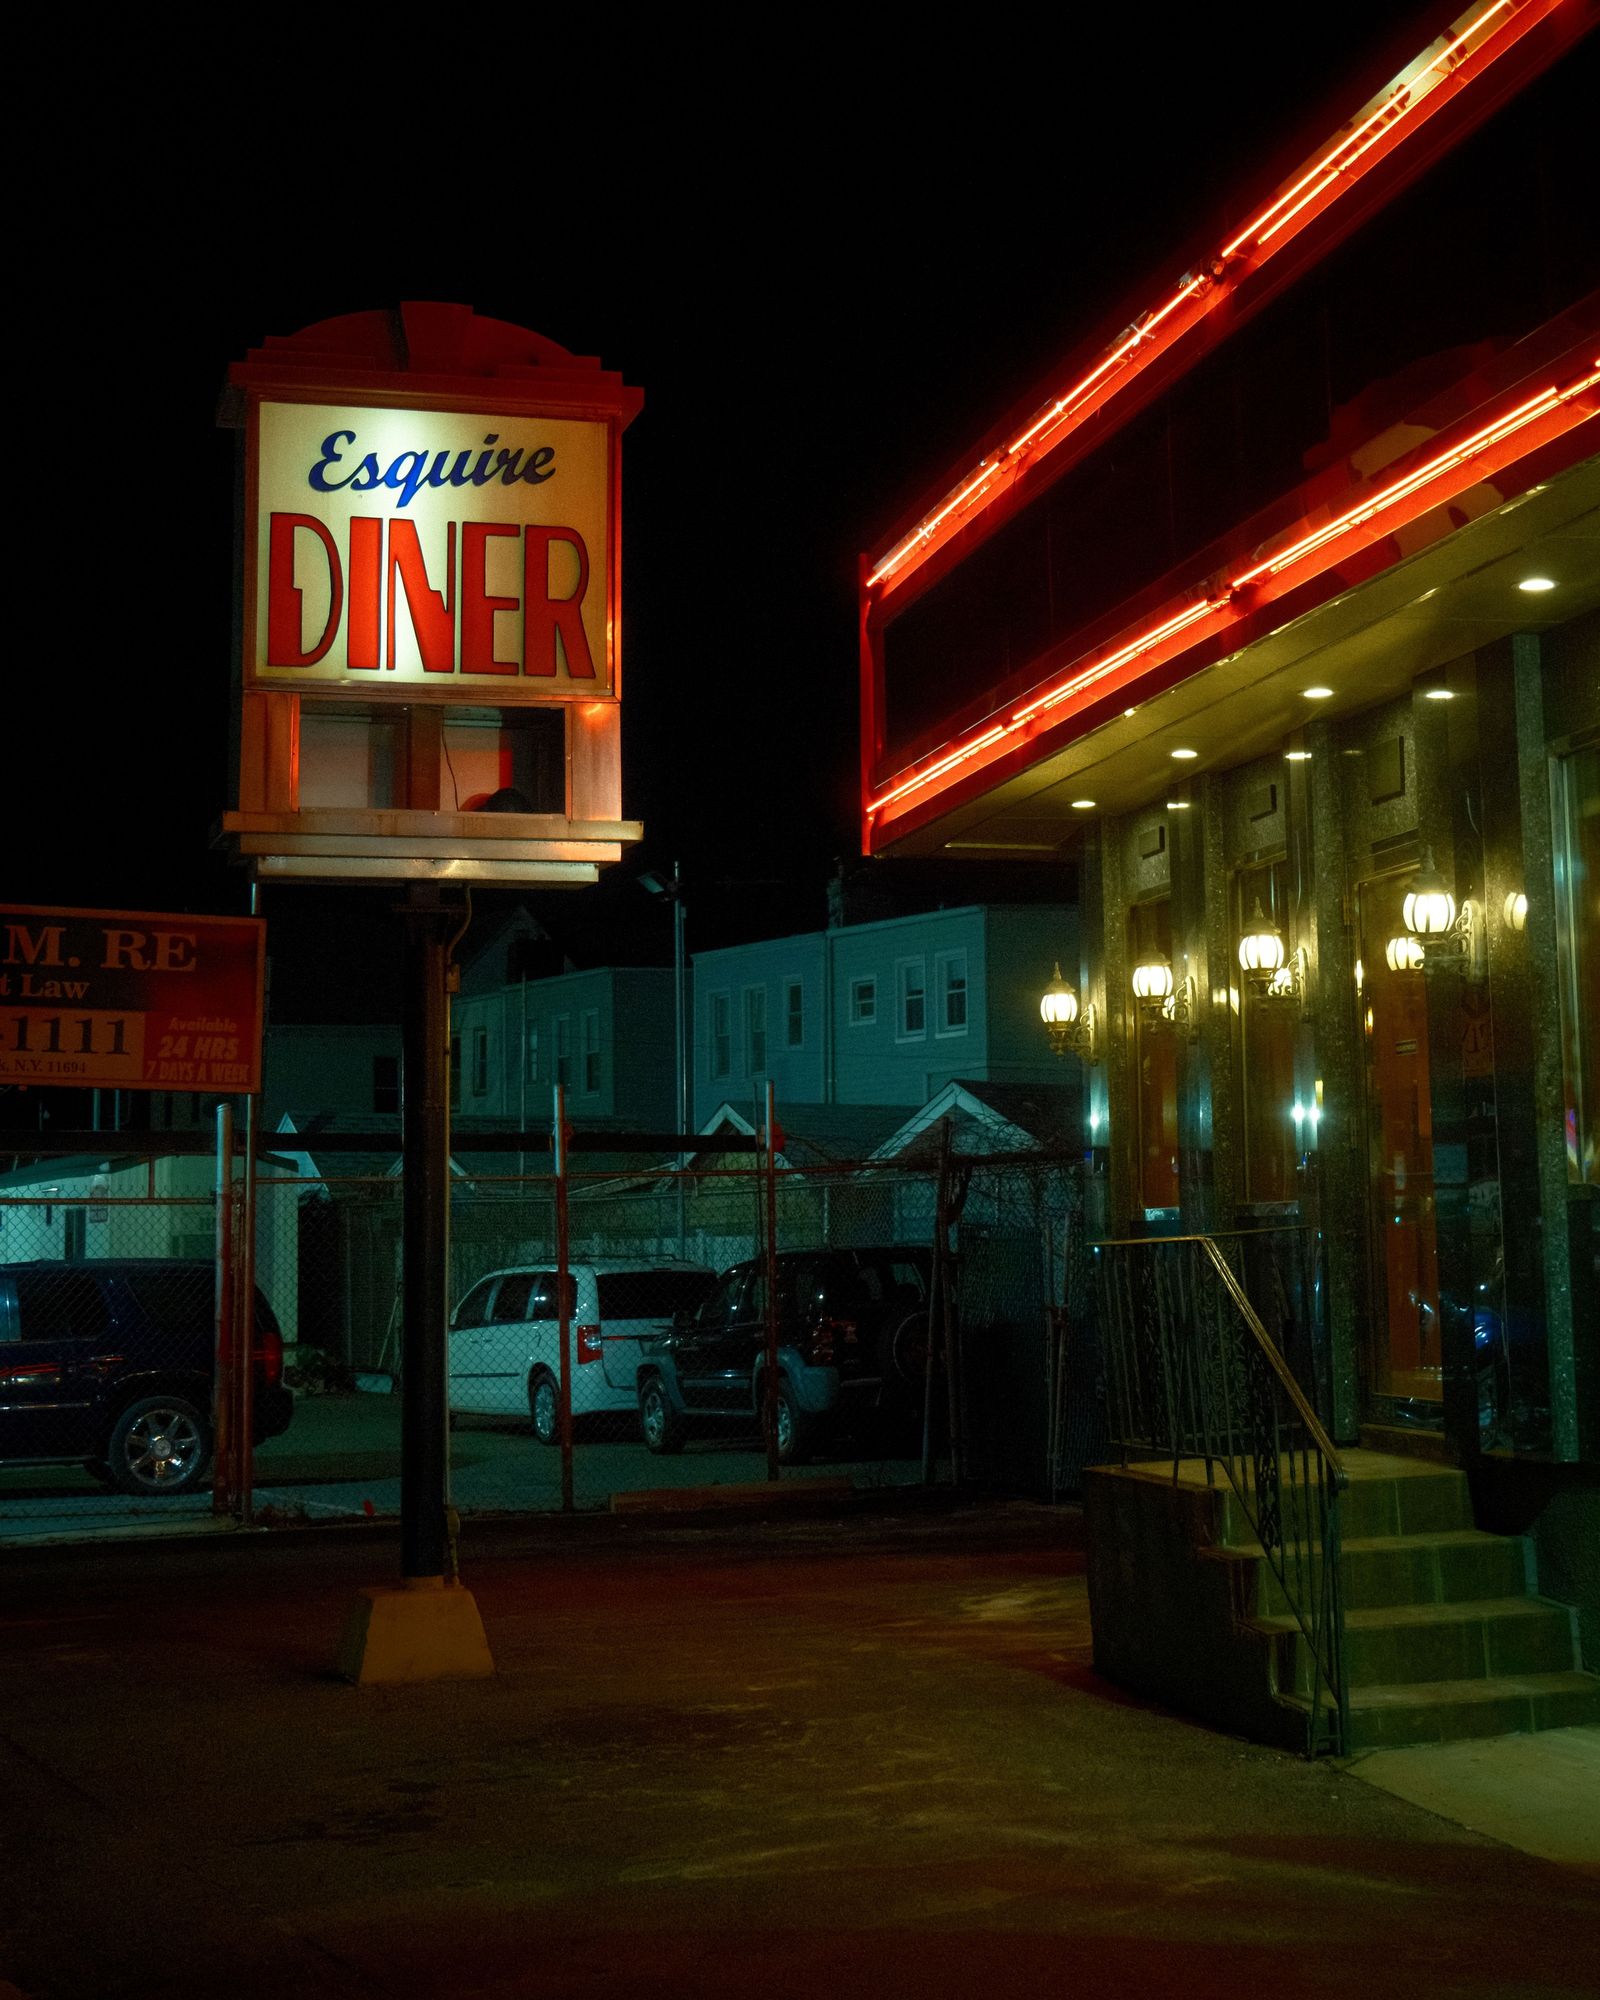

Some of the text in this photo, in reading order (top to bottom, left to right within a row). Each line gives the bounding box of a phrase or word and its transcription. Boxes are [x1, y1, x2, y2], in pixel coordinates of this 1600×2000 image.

[308, 430, 556, 508] Esquire
[267, 512, 597, 678] DINER
[2, 925, 197, 972] M. RE
[20, 973, 91, 999] Law
[168, 1017, 238, 1032] Available
[158, 1035, 240, 1060] 24 HRS
[145, 1060, 250, 1083] 7 DAYS A WEEK
